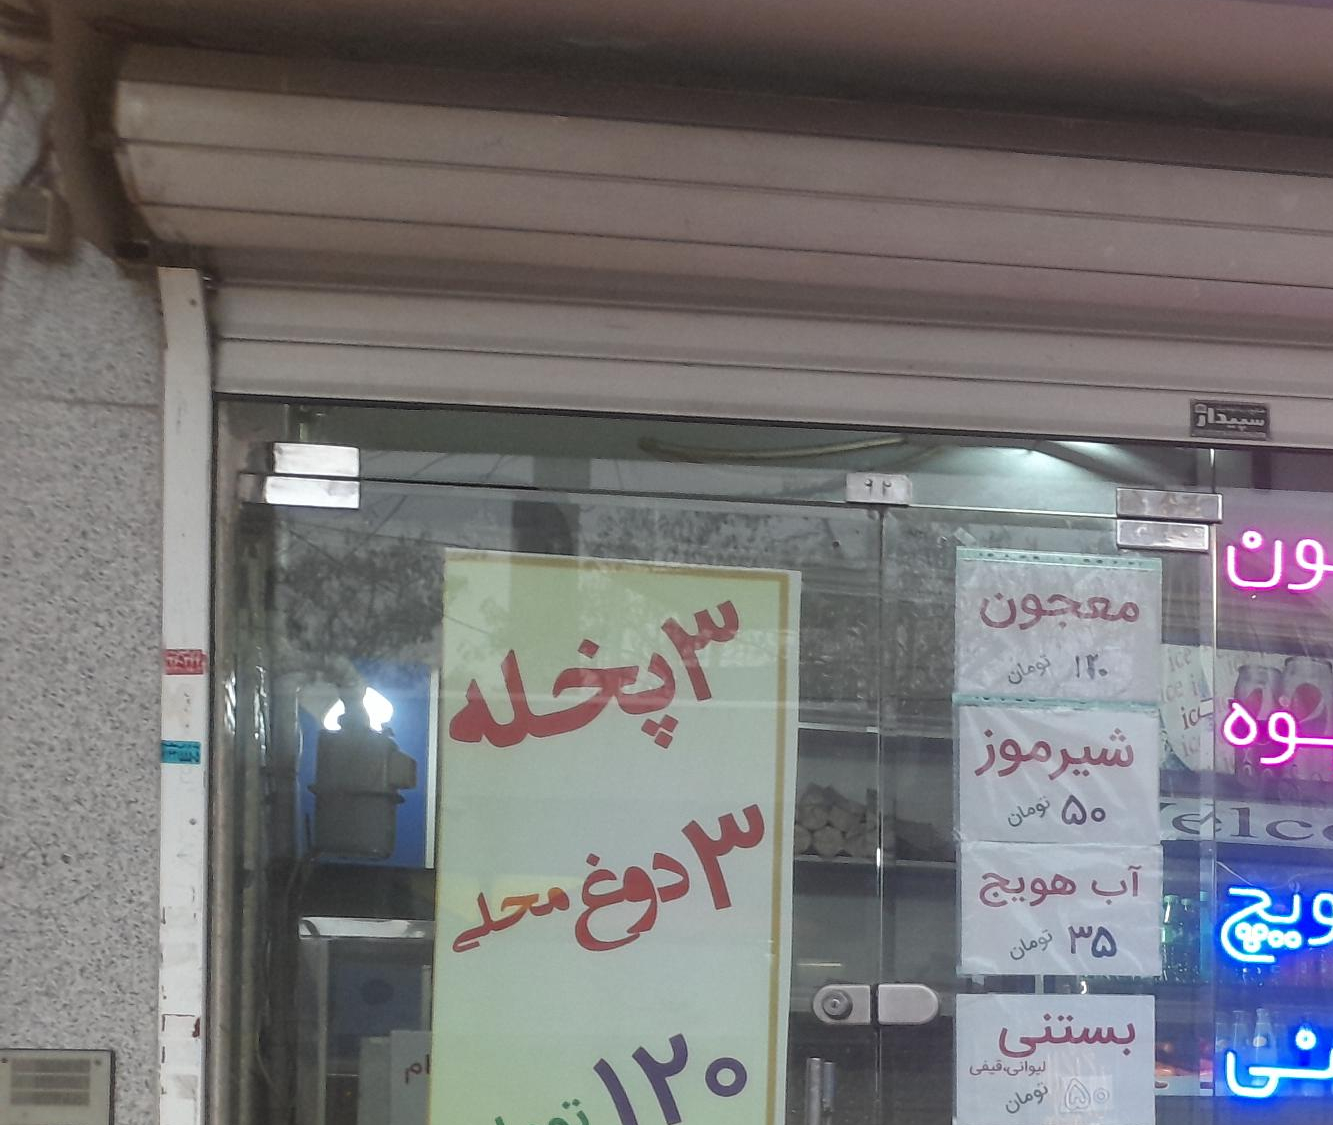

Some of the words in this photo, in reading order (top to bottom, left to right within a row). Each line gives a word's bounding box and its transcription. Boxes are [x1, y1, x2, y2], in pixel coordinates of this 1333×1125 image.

[979, 591, 1141, 630] معجون
[662, 600, 741, 703] ۳
[1007, 654, 1052, 685] تومان
[448, 638, 682, 750] پخله
[1007, 796, 1052, 828] تومان
[1061, 795, 1107, 827] ۵۰
[681, 803, 766, 910] ۳
[574, 852, 689, 953] دوغ
[978, 869, 1077, 907] هویج
[1092, 865, 1142, 906] آب
[450, 885, 570, 954] محلی
[1009, 928, 1054, 961] تومان
[1068, 923, 1118, 960] ۳۵
[998, 1011, 1137, 1059] بستنی
[1004, 1081, 1050, 1114] تومان
[1064, 1077, 1111, 1112] ۵۰
